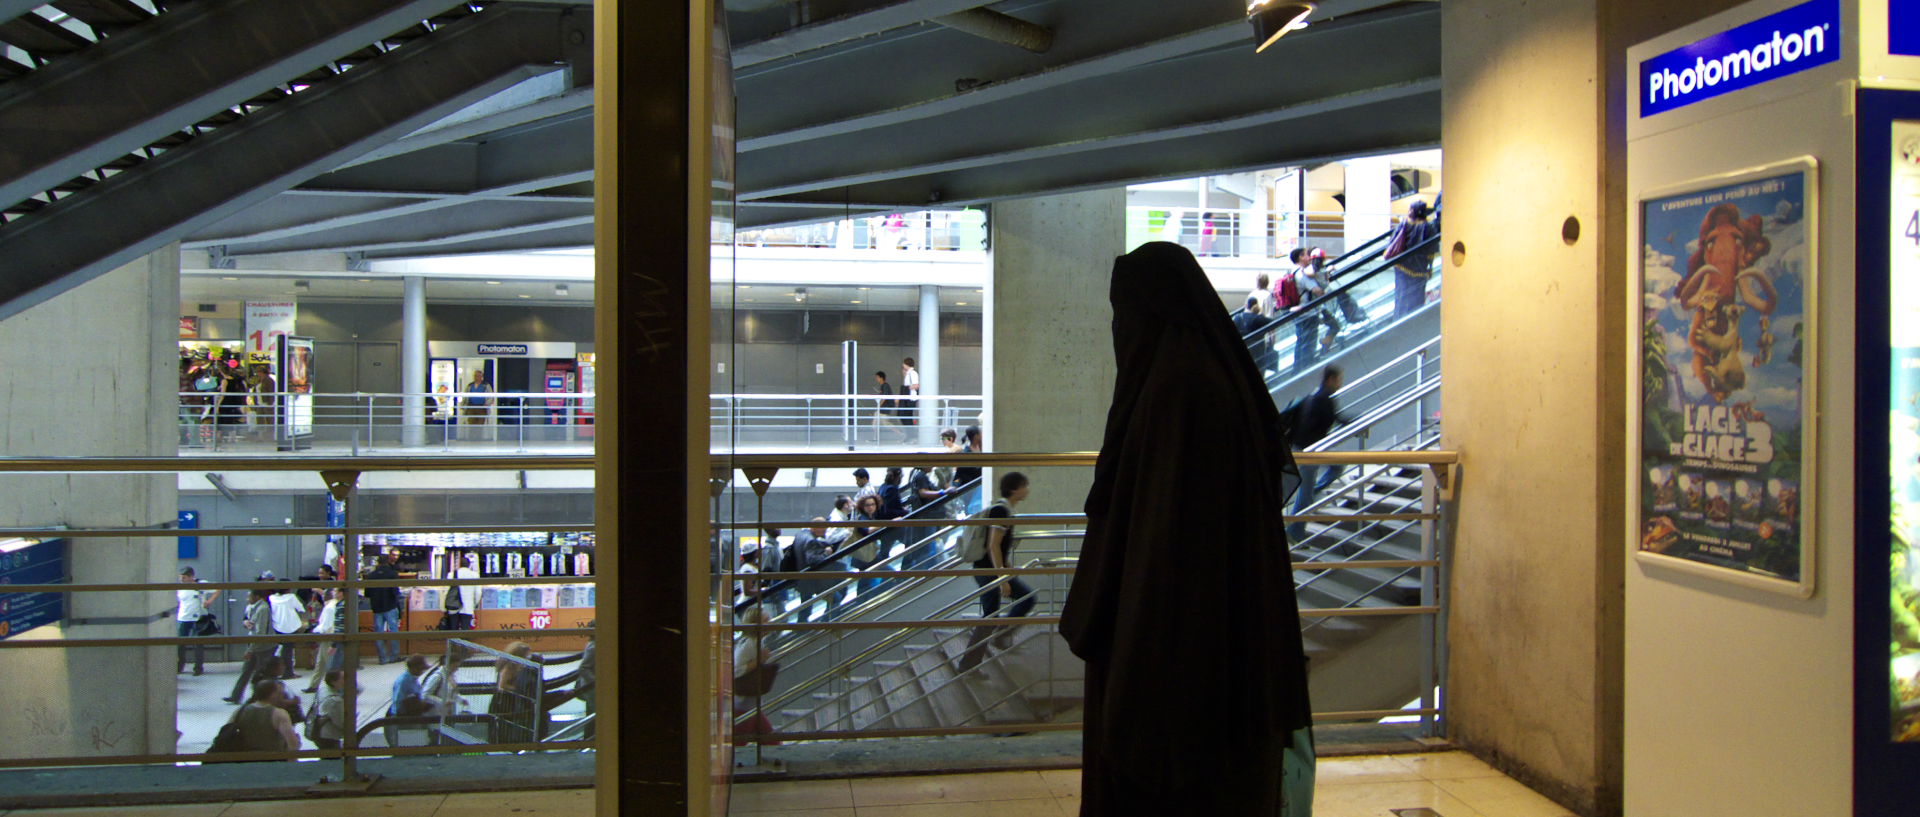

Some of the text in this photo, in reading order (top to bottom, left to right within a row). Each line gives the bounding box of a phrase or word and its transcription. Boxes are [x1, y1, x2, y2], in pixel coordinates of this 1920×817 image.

[1650, 25, 1824, 104] Photomaton
[479, 344, 526, 353] Photomaton
[1683, 433, 1745, 461] GLACE
[1745, 421, 1773, 464] 3
[530, 616, 552, 629] 10€
